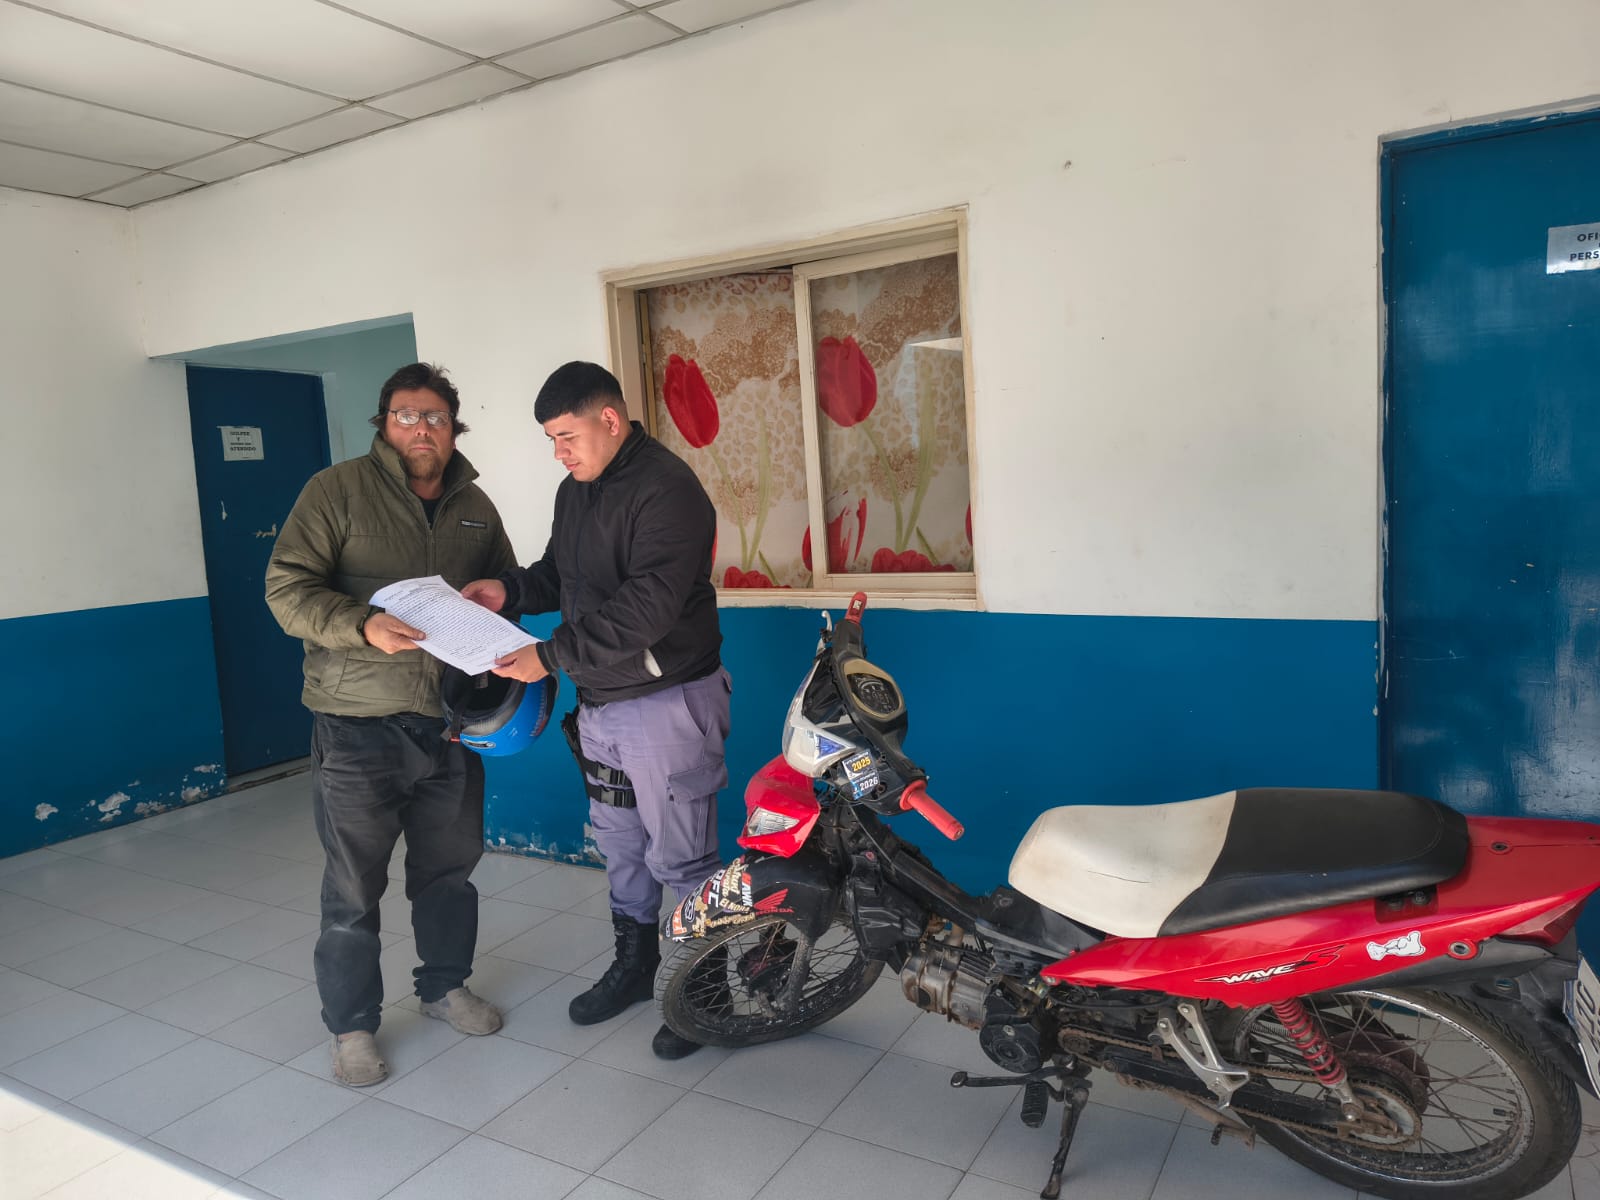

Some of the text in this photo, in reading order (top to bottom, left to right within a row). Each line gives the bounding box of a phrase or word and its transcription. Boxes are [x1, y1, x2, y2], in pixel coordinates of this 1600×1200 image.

[1577, 232, 1600, 242] OFI
[851, 756, 871, 772] 2025
[859, 776, 879, 792] 2026
[1221, 962, 1297, 984] WAVE
